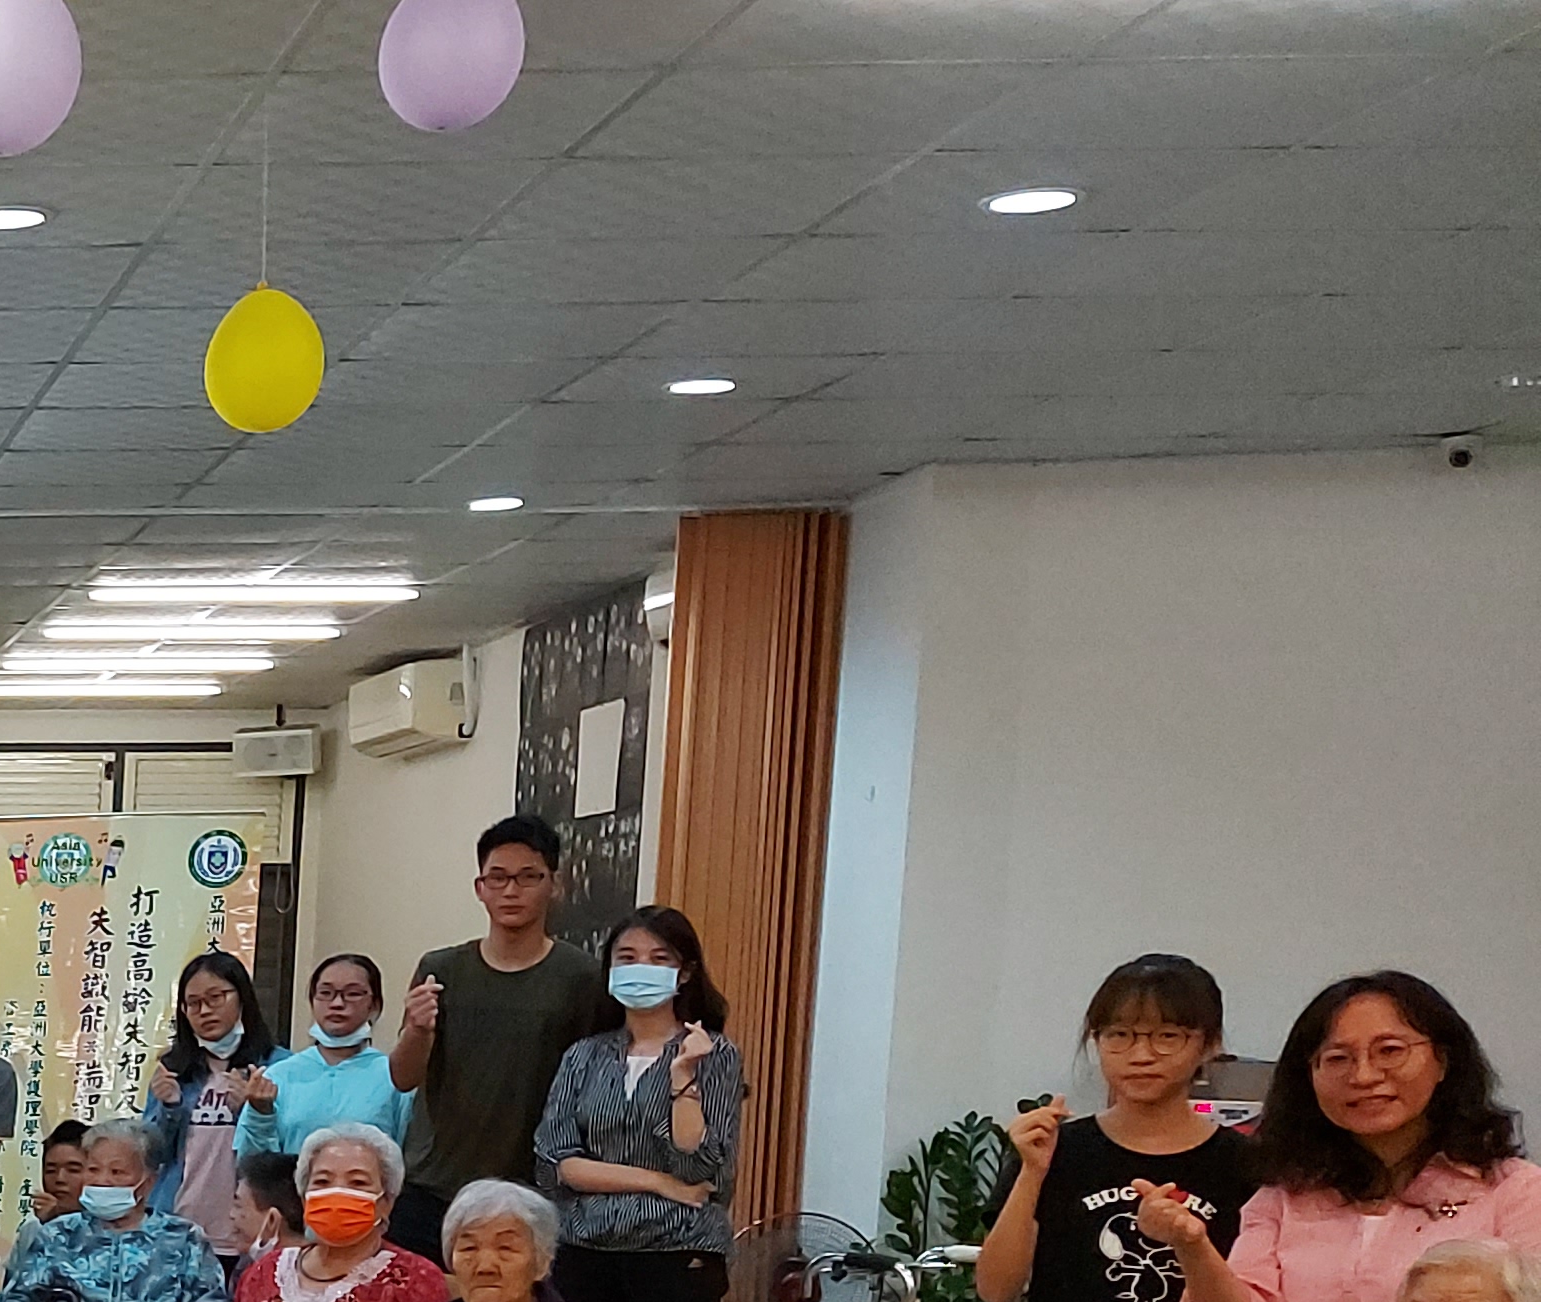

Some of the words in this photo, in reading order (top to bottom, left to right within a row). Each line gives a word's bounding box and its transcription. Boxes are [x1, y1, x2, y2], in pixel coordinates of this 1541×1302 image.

[51, 838, 80, 850] Asia
[31, 855, 103, 868] University
[49, 872, 78, 884] USR
[114, 885, 160, 1118] 打造高齡失智友
[1082, 1186, 1139, 1211] HUG
[1183, 1194, 1218, 1220] RE
